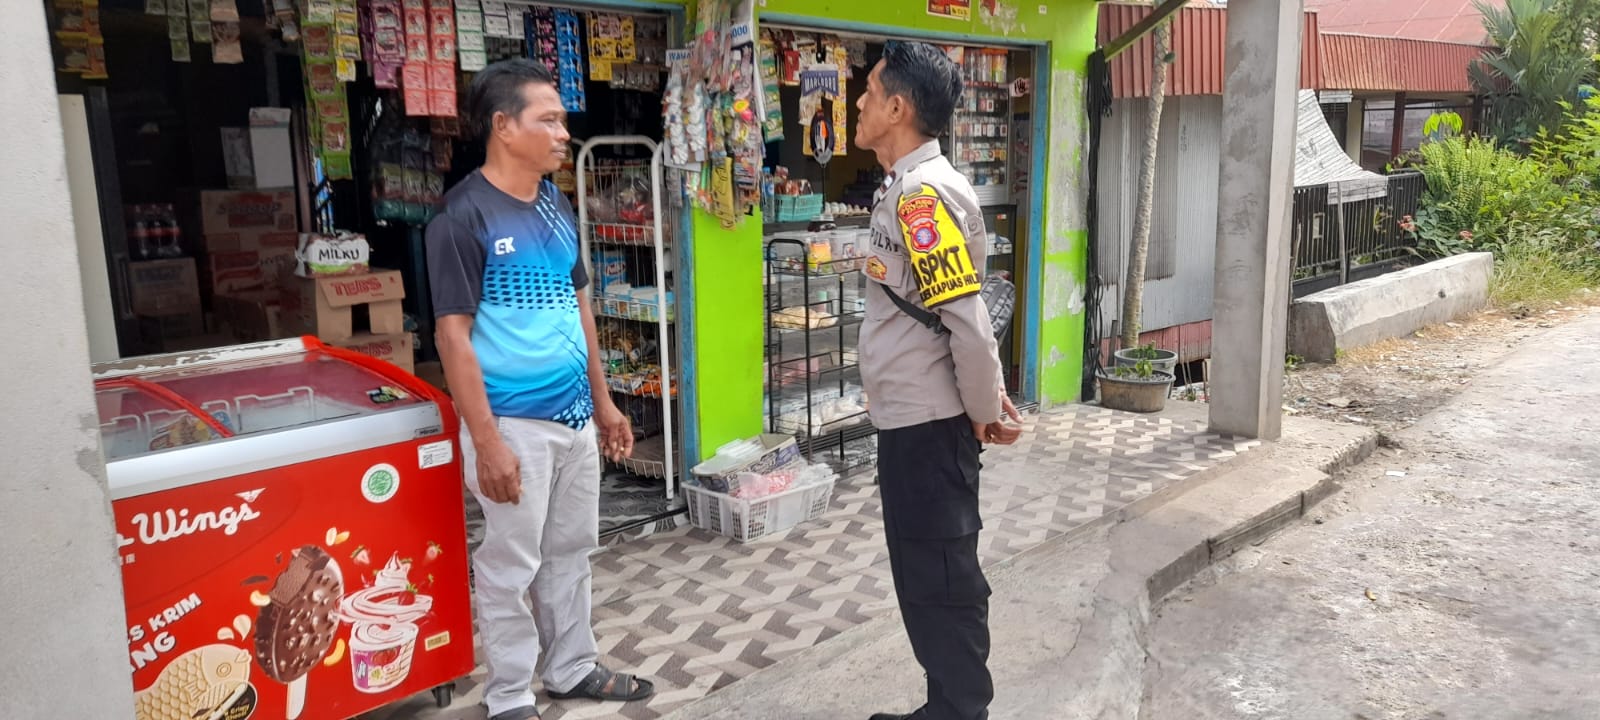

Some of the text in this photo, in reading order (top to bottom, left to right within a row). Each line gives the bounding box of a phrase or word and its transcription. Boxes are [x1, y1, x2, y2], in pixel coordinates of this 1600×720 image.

[319, 248, 360, 261] MILKU
[931, 277, 964, 297] KAPUAS
[131, 502, 261, 545] Wings
[127, 592, 203, 645] S KRIM
[130, 631, 176, 673] NG
